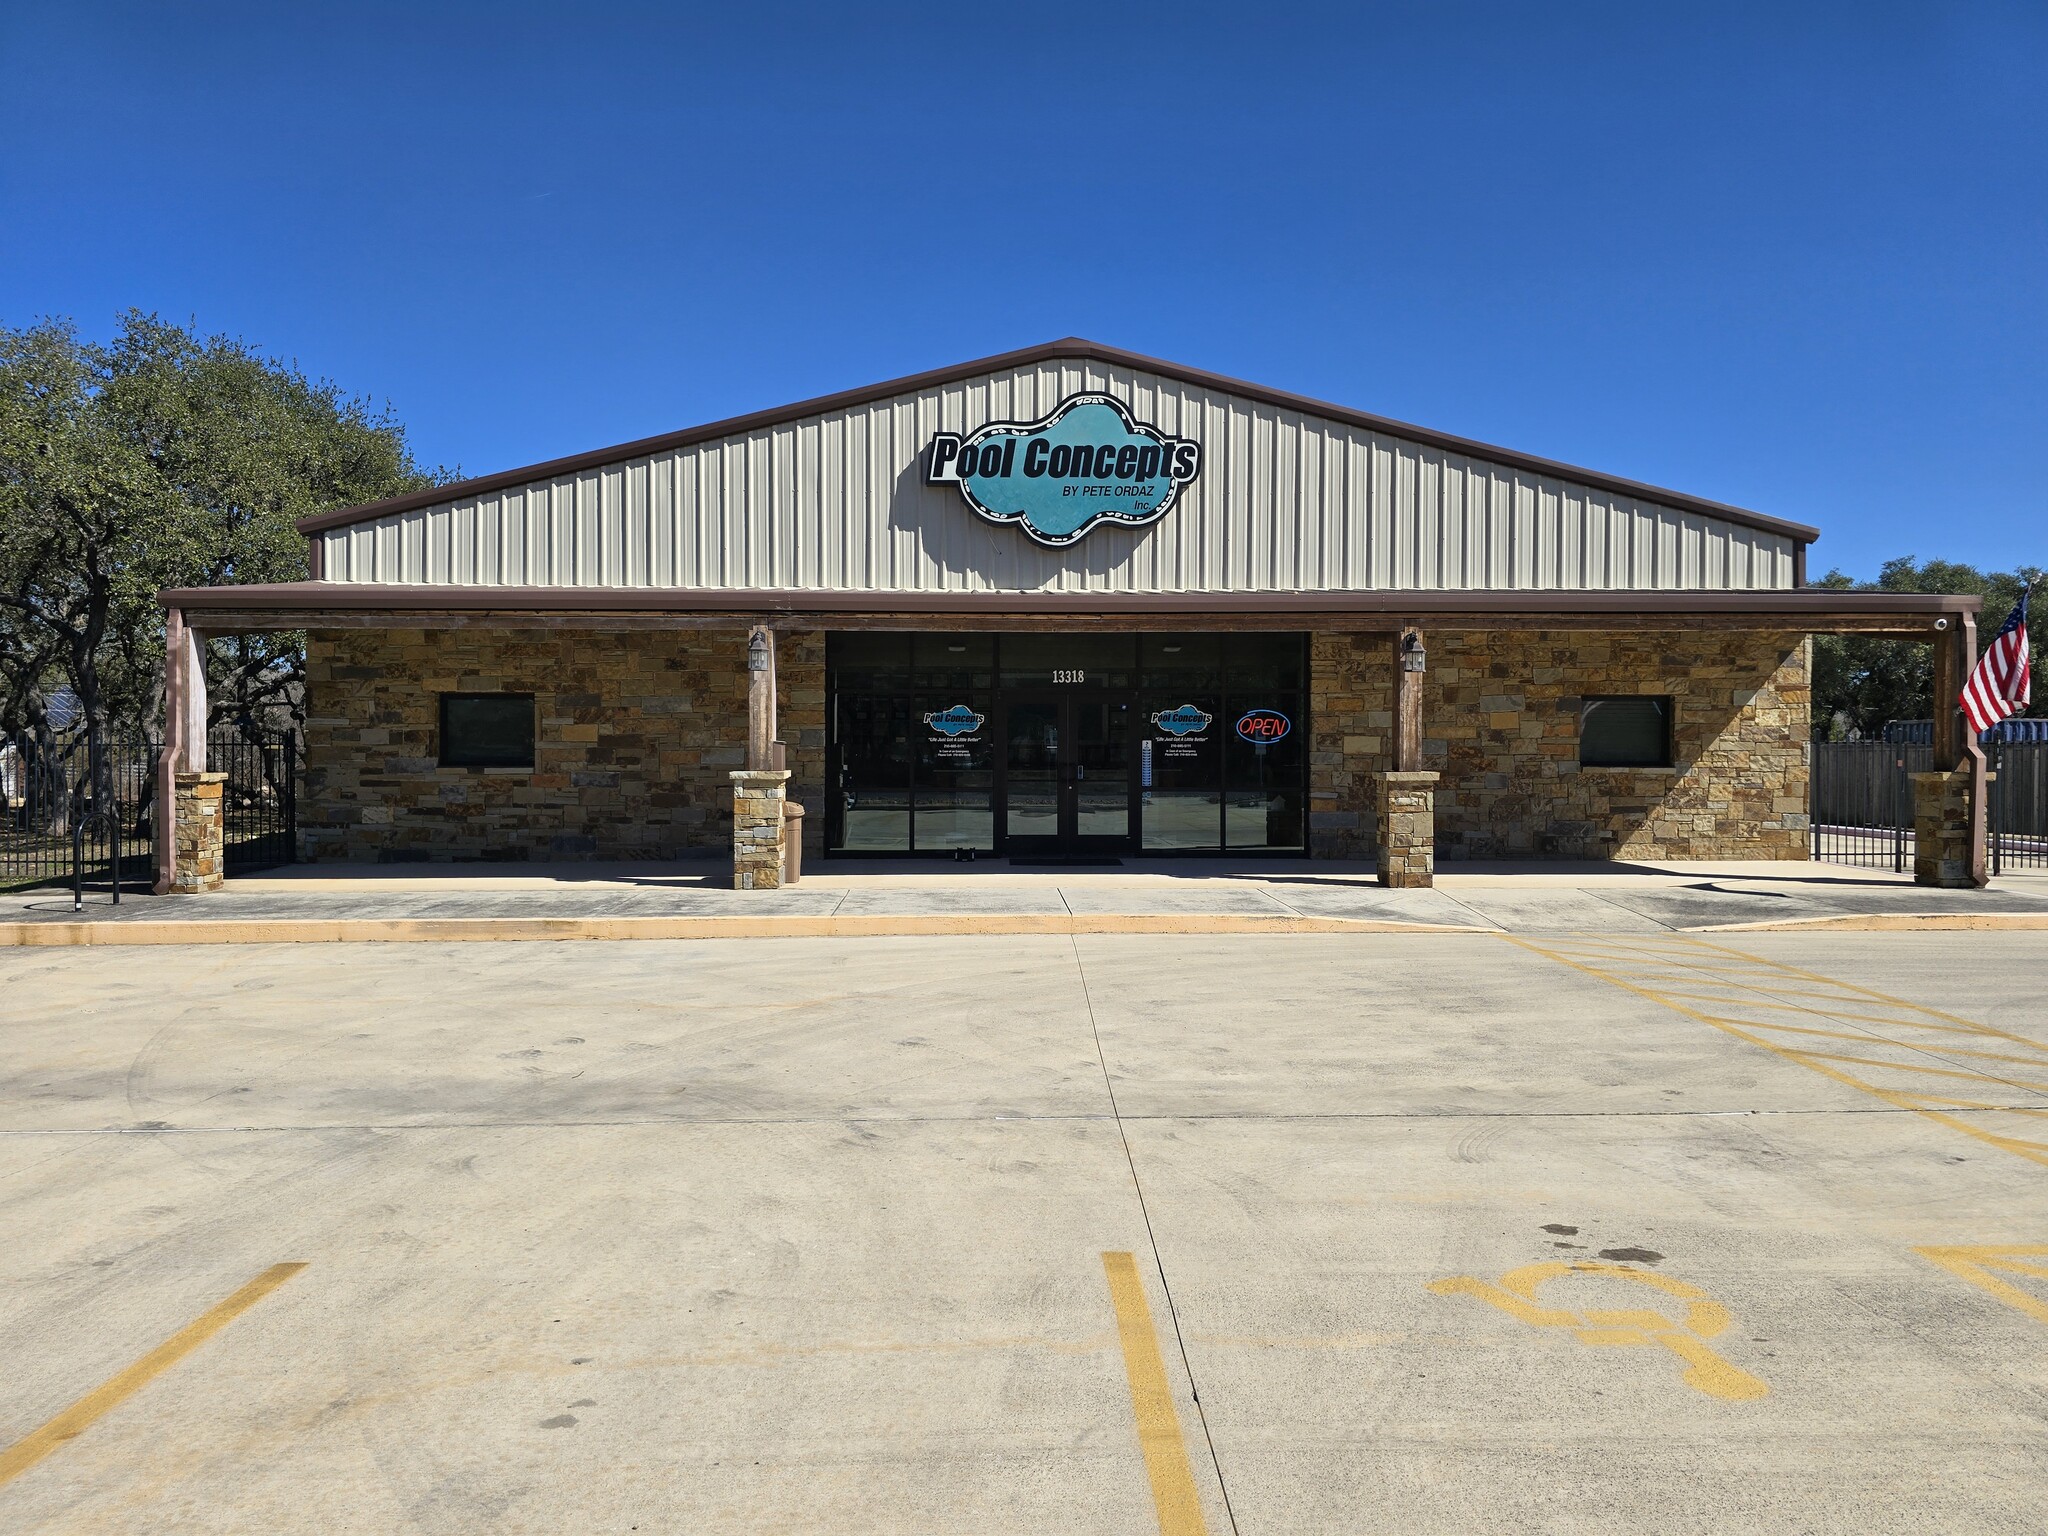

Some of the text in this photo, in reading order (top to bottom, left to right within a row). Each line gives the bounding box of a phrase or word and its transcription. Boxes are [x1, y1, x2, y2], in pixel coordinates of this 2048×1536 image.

[932, 438, 1196, 483] Pool Concepts
[1062, 485, 1155, 497] BY PETE ORDAZ
[1134, 500, 1151, 510] Inc.
[1052, 669, 1085, 684] 13318
[924, 713, 984, 723] Pool Concepts
[1152, 713, 1212, 723] Pool Concepts
[1239, 717, 1286, 736] OPEN
